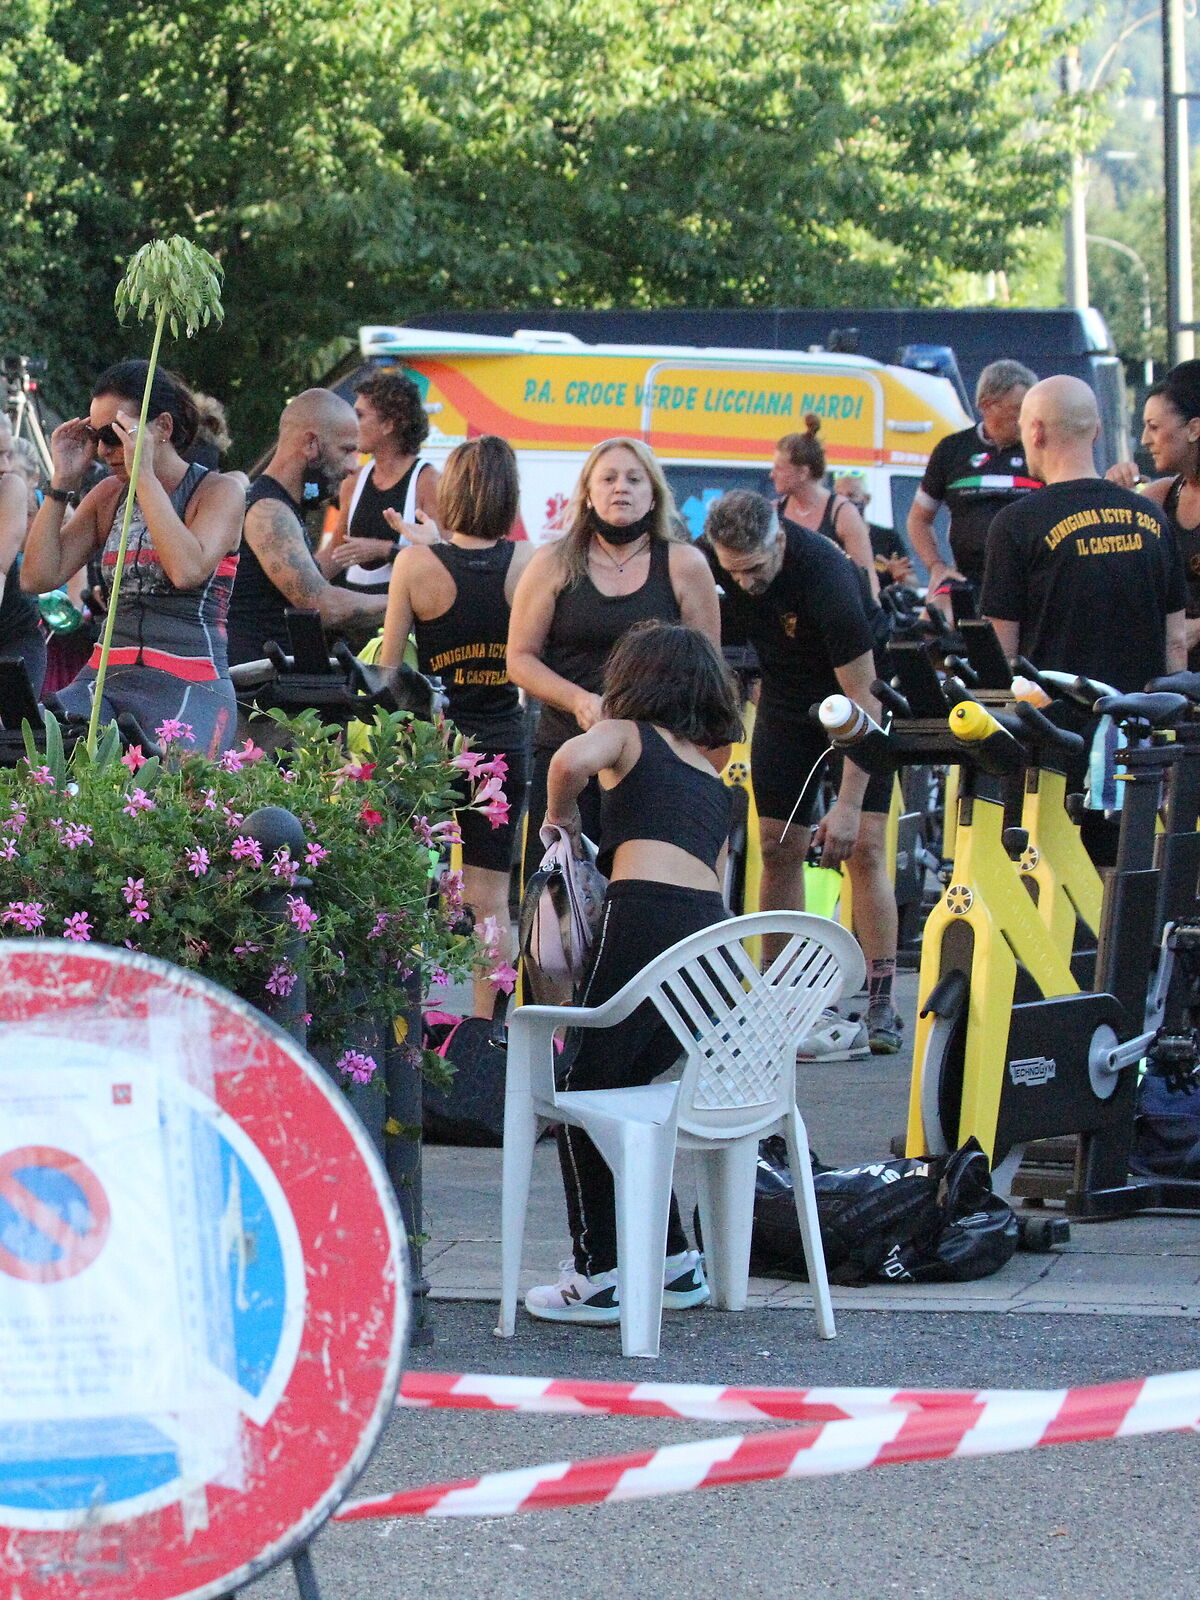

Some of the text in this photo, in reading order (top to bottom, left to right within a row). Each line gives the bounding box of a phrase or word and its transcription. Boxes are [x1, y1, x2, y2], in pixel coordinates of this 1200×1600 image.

[523, 378, 864, 420] P.A. CROCE VERDE LICCIANA NARDI
[1044, 509, 1101, 551] LUNIGIANA
[1075, 532, 1143, 556] IL CASTELLO
[430, 644, 485, 671] LUNIGIANA
[454, 668, 508, 685] IL CASTELL
